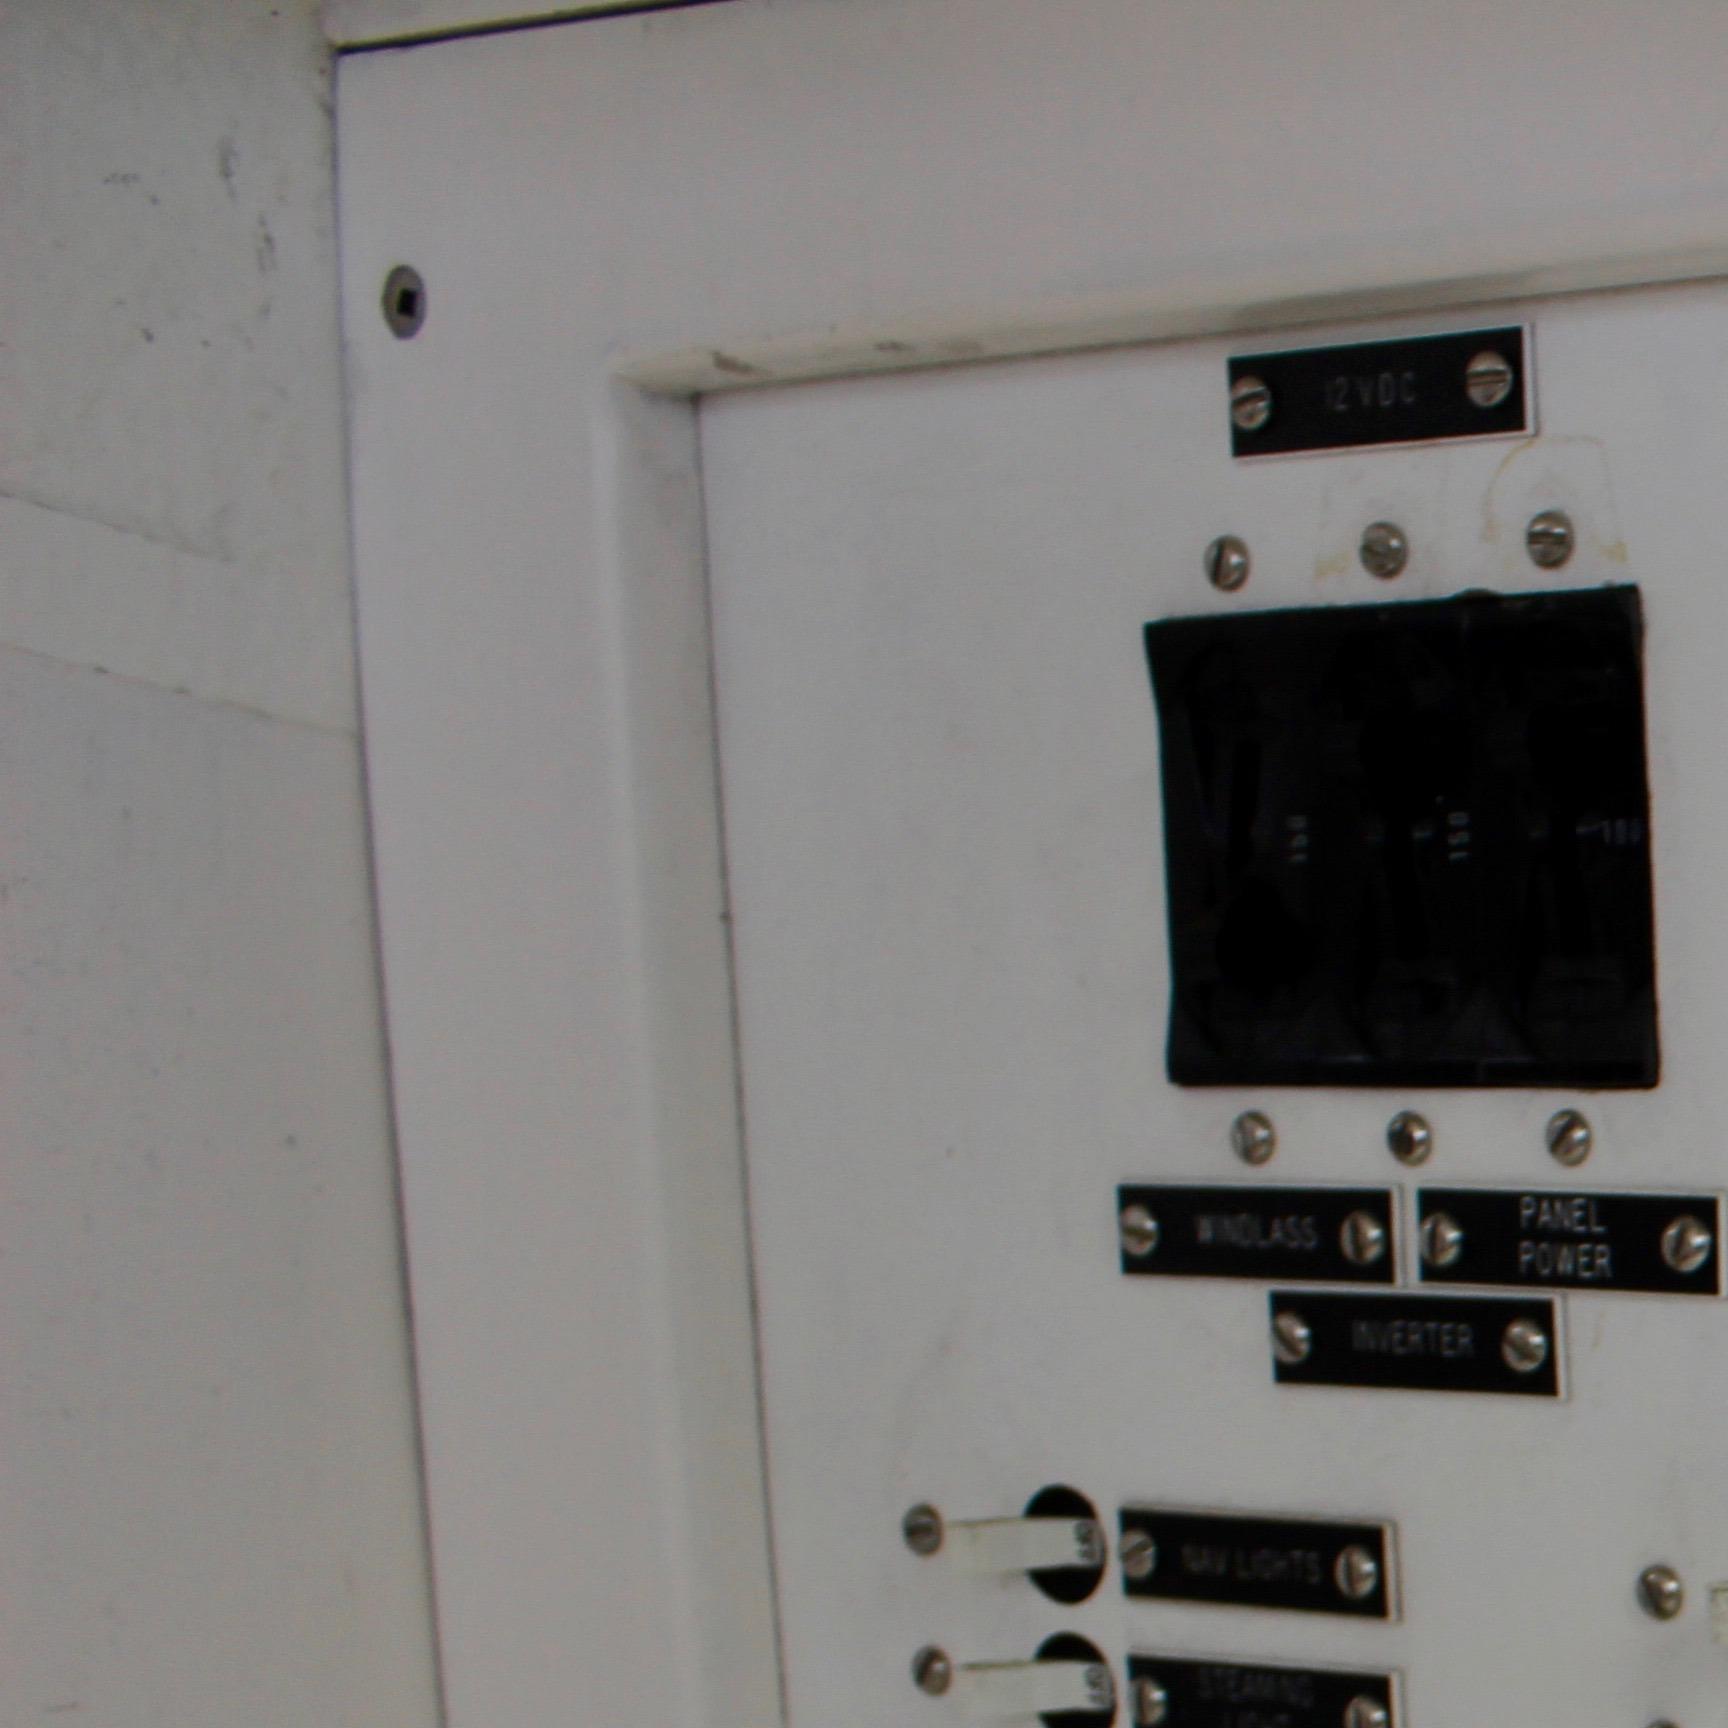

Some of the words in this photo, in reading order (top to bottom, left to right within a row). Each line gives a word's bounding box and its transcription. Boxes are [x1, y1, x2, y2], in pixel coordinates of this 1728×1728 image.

[1195, 1213, 1320, 1251] WINDLASS
[1518, 1195, 1608, 1234] PANEL
[1517, 1241, 1615, 1280] POWER
[1350, 1318, 1478, 1359] INVERTER
